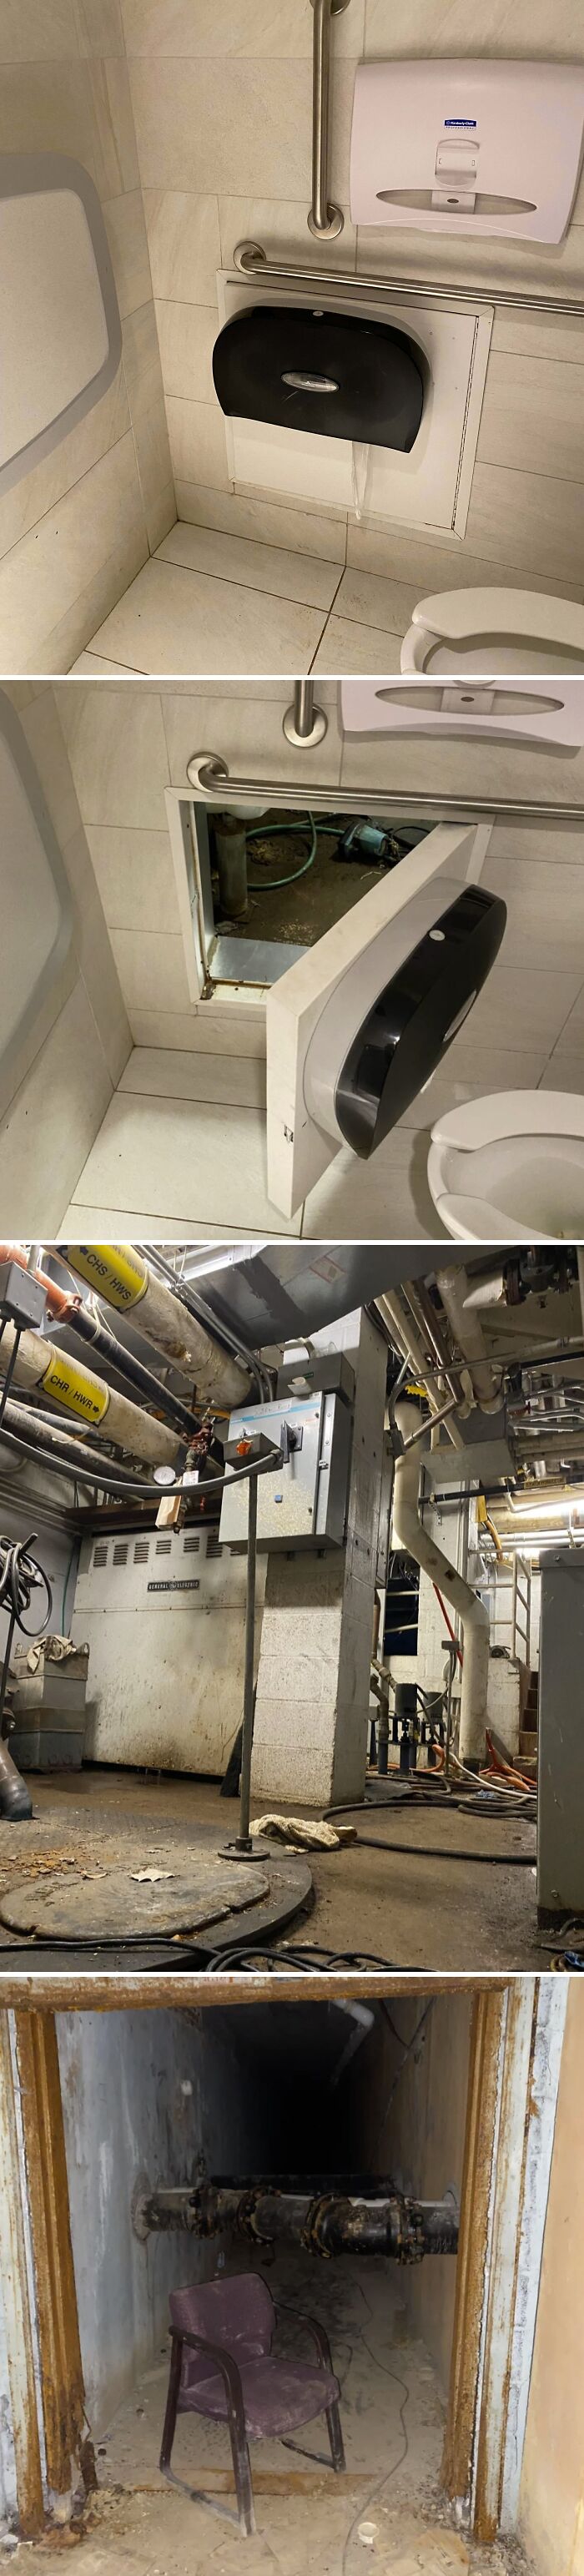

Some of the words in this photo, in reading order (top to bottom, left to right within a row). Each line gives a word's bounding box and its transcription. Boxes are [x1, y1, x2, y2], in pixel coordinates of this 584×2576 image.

[87, 1254, 108, 1276] CHS
[109, 1278, 132, 1300] HWS
[50, 1375, 70, 1393] CHR
[73, 1390, 93, 1409] HWR
